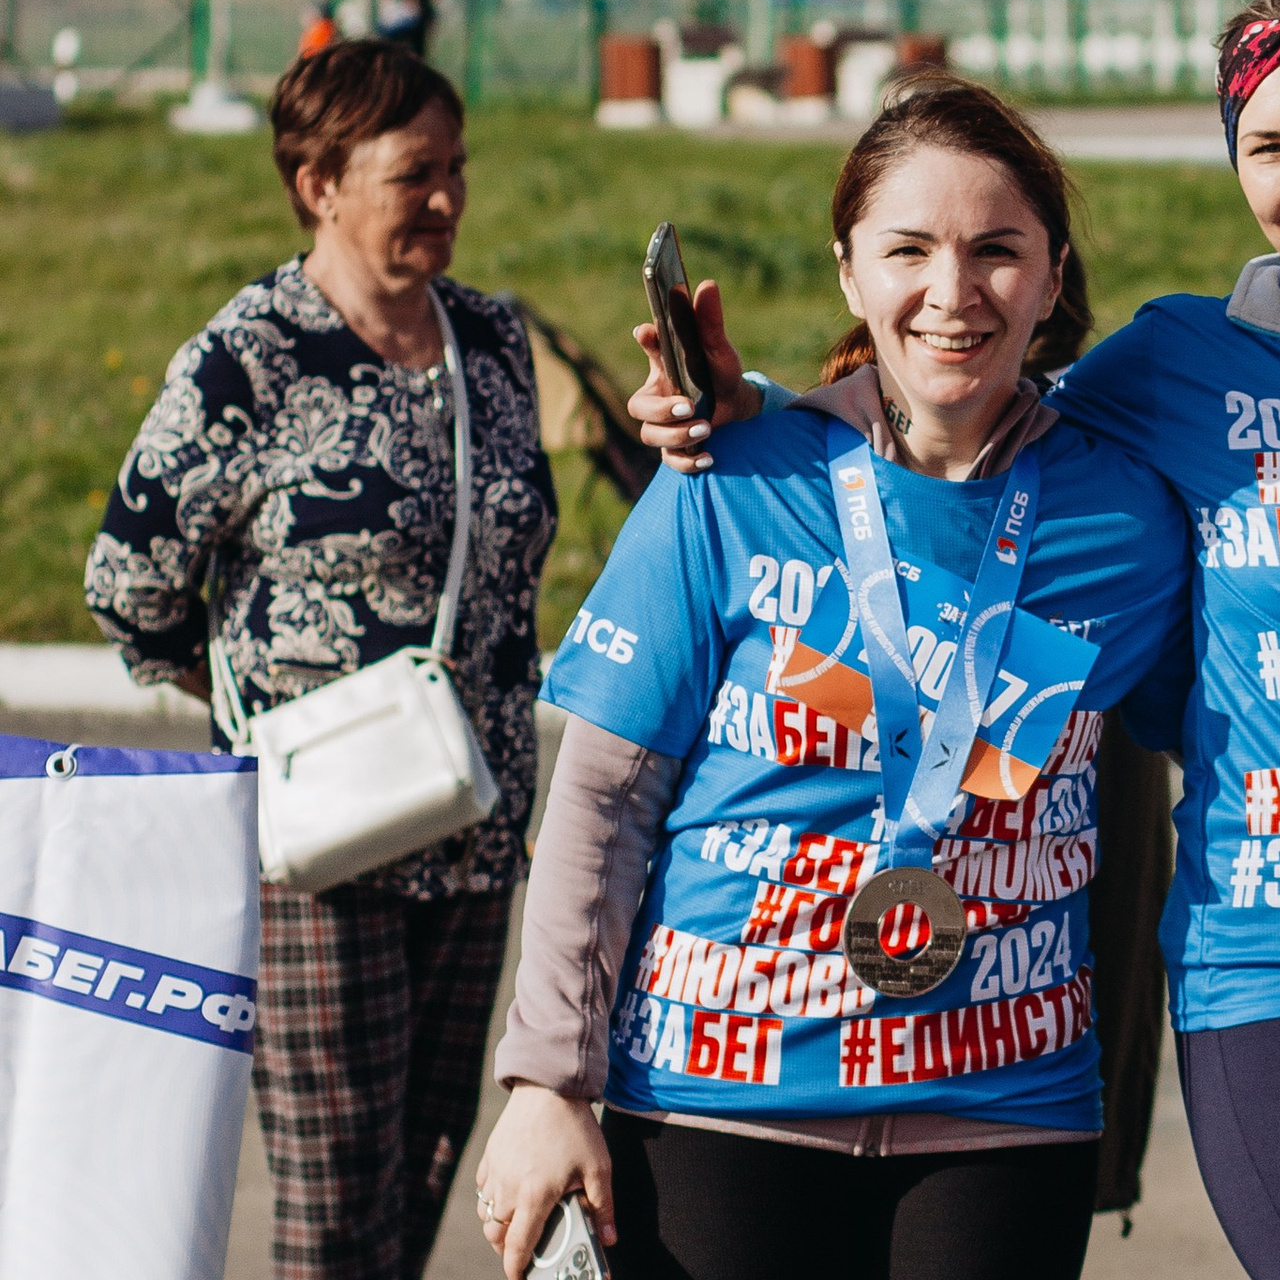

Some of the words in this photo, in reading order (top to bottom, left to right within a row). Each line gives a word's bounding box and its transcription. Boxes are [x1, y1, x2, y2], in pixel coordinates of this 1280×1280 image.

[847, 495, 873, 541] ПСБ
[1005, 490, 1030, 537] ПСБ
[970, 910, 1073, 1002] 2024
[613, 991, 784, 1086] #ЗАБЕГ
